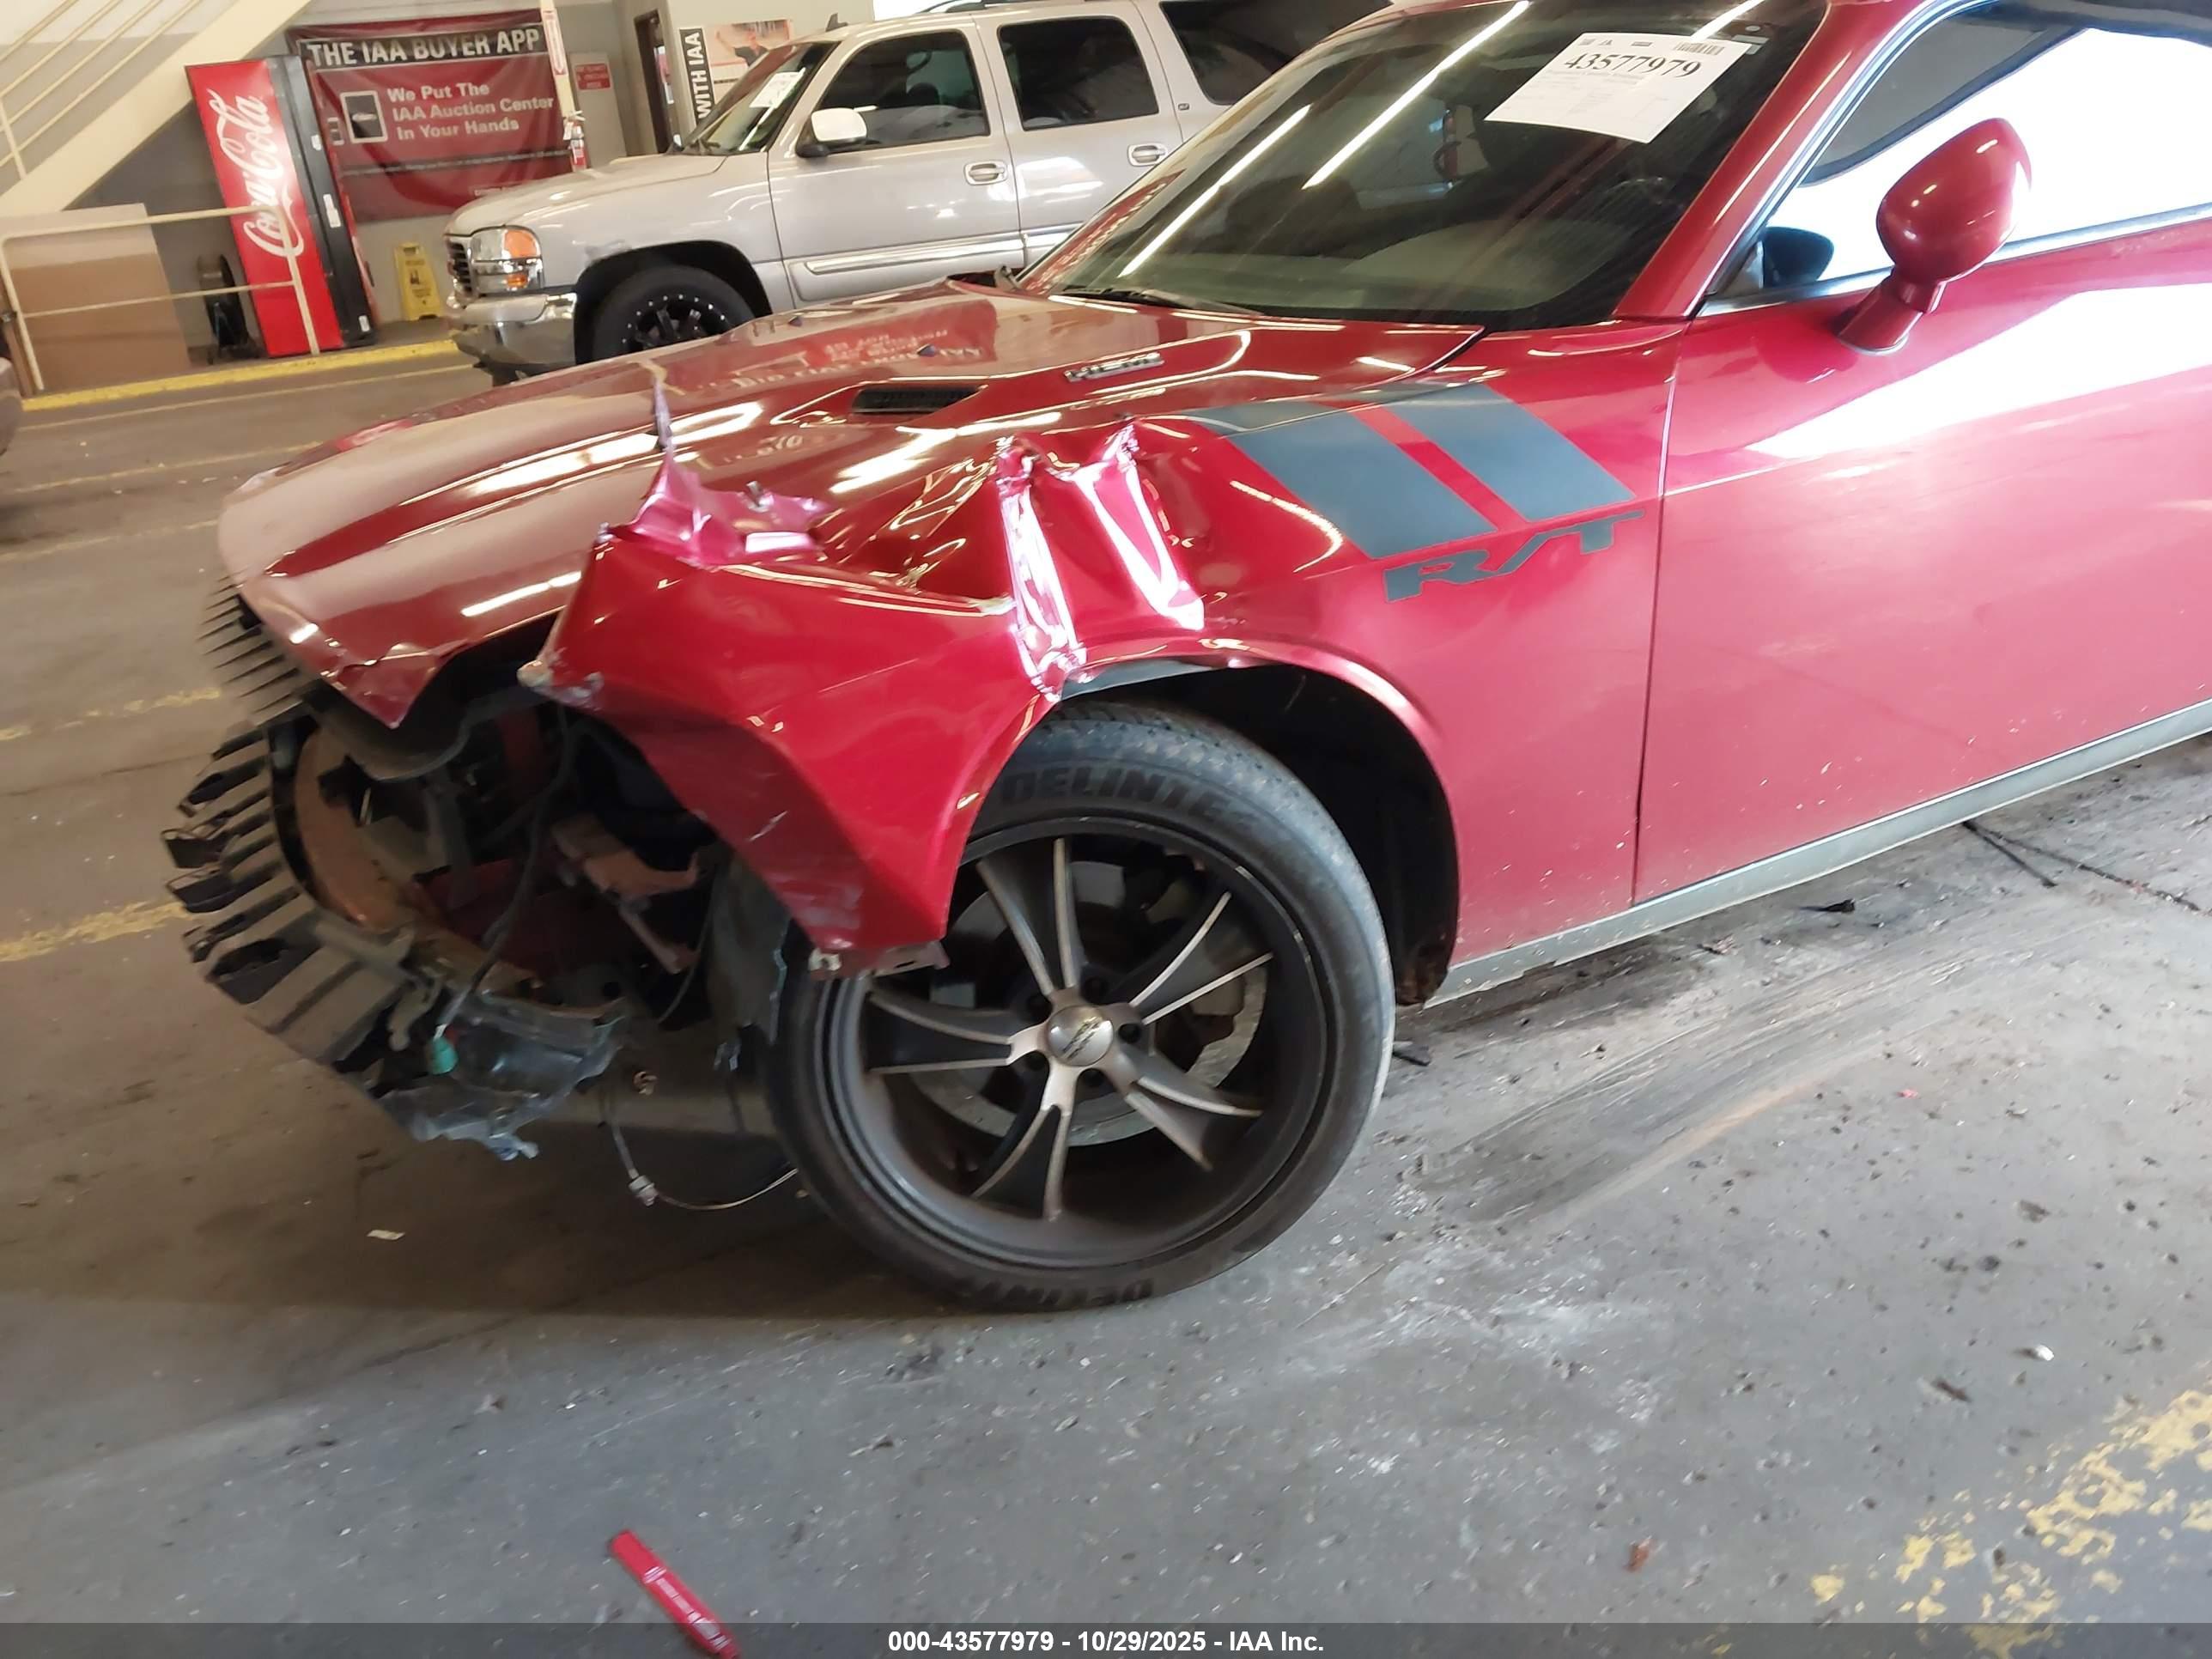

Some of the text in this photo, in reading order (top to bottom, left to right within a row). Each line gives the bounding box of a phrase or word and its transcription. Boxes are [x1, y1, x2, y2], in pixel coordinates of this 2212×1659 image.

[307, 28, 539, 67] THE IAA BUYER APP
[684, 32, 712, 118] WITH IAA
[1564, 52, 1701, 78] 43577979
[387, 82, 490, 103] We Put The
[392, 96, 554, 121] IAA Auction Center
[397, 118, 520, 140] In Your Hands
[1382, 508, 1645, 603] R/T
